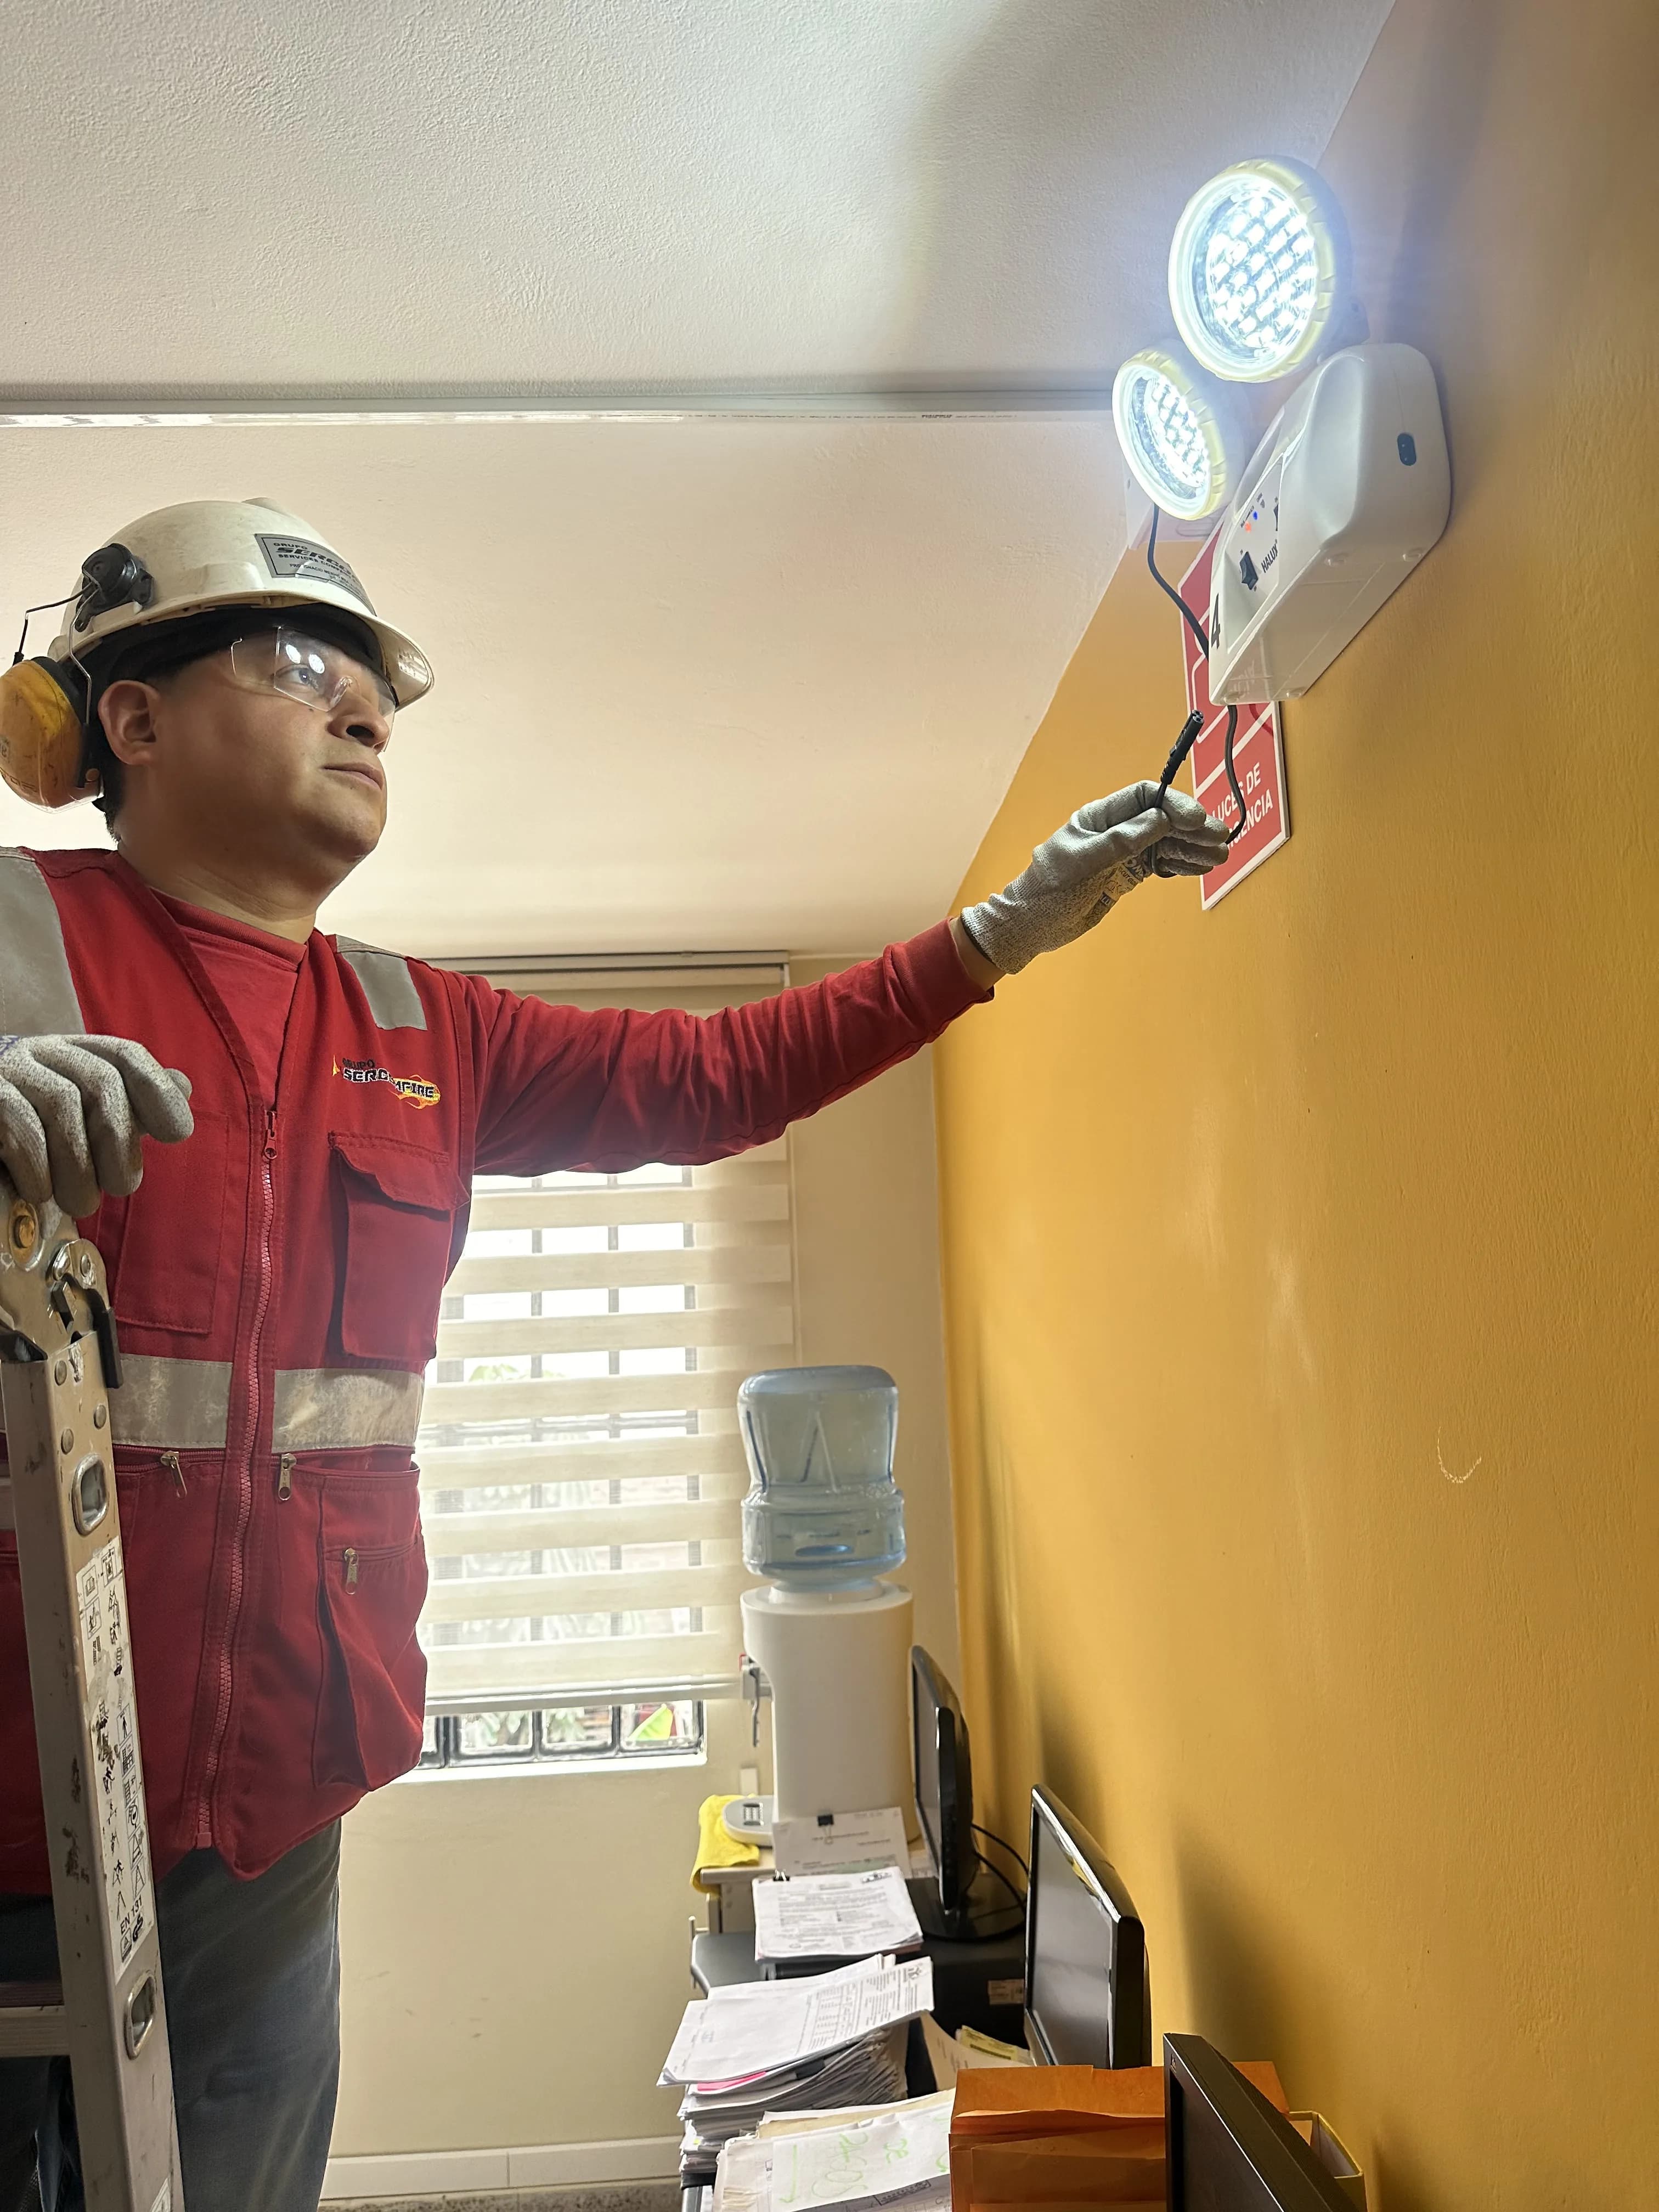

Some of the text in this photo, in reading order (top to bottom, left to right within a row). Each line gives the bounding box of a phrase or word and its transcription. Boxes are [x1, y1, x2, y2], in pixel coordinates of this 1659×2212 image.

[1211, 592, 1221, 650] 4
[1246, 761, 1261, 795] DE
[120, 1894, 143, 1936] EN 131
